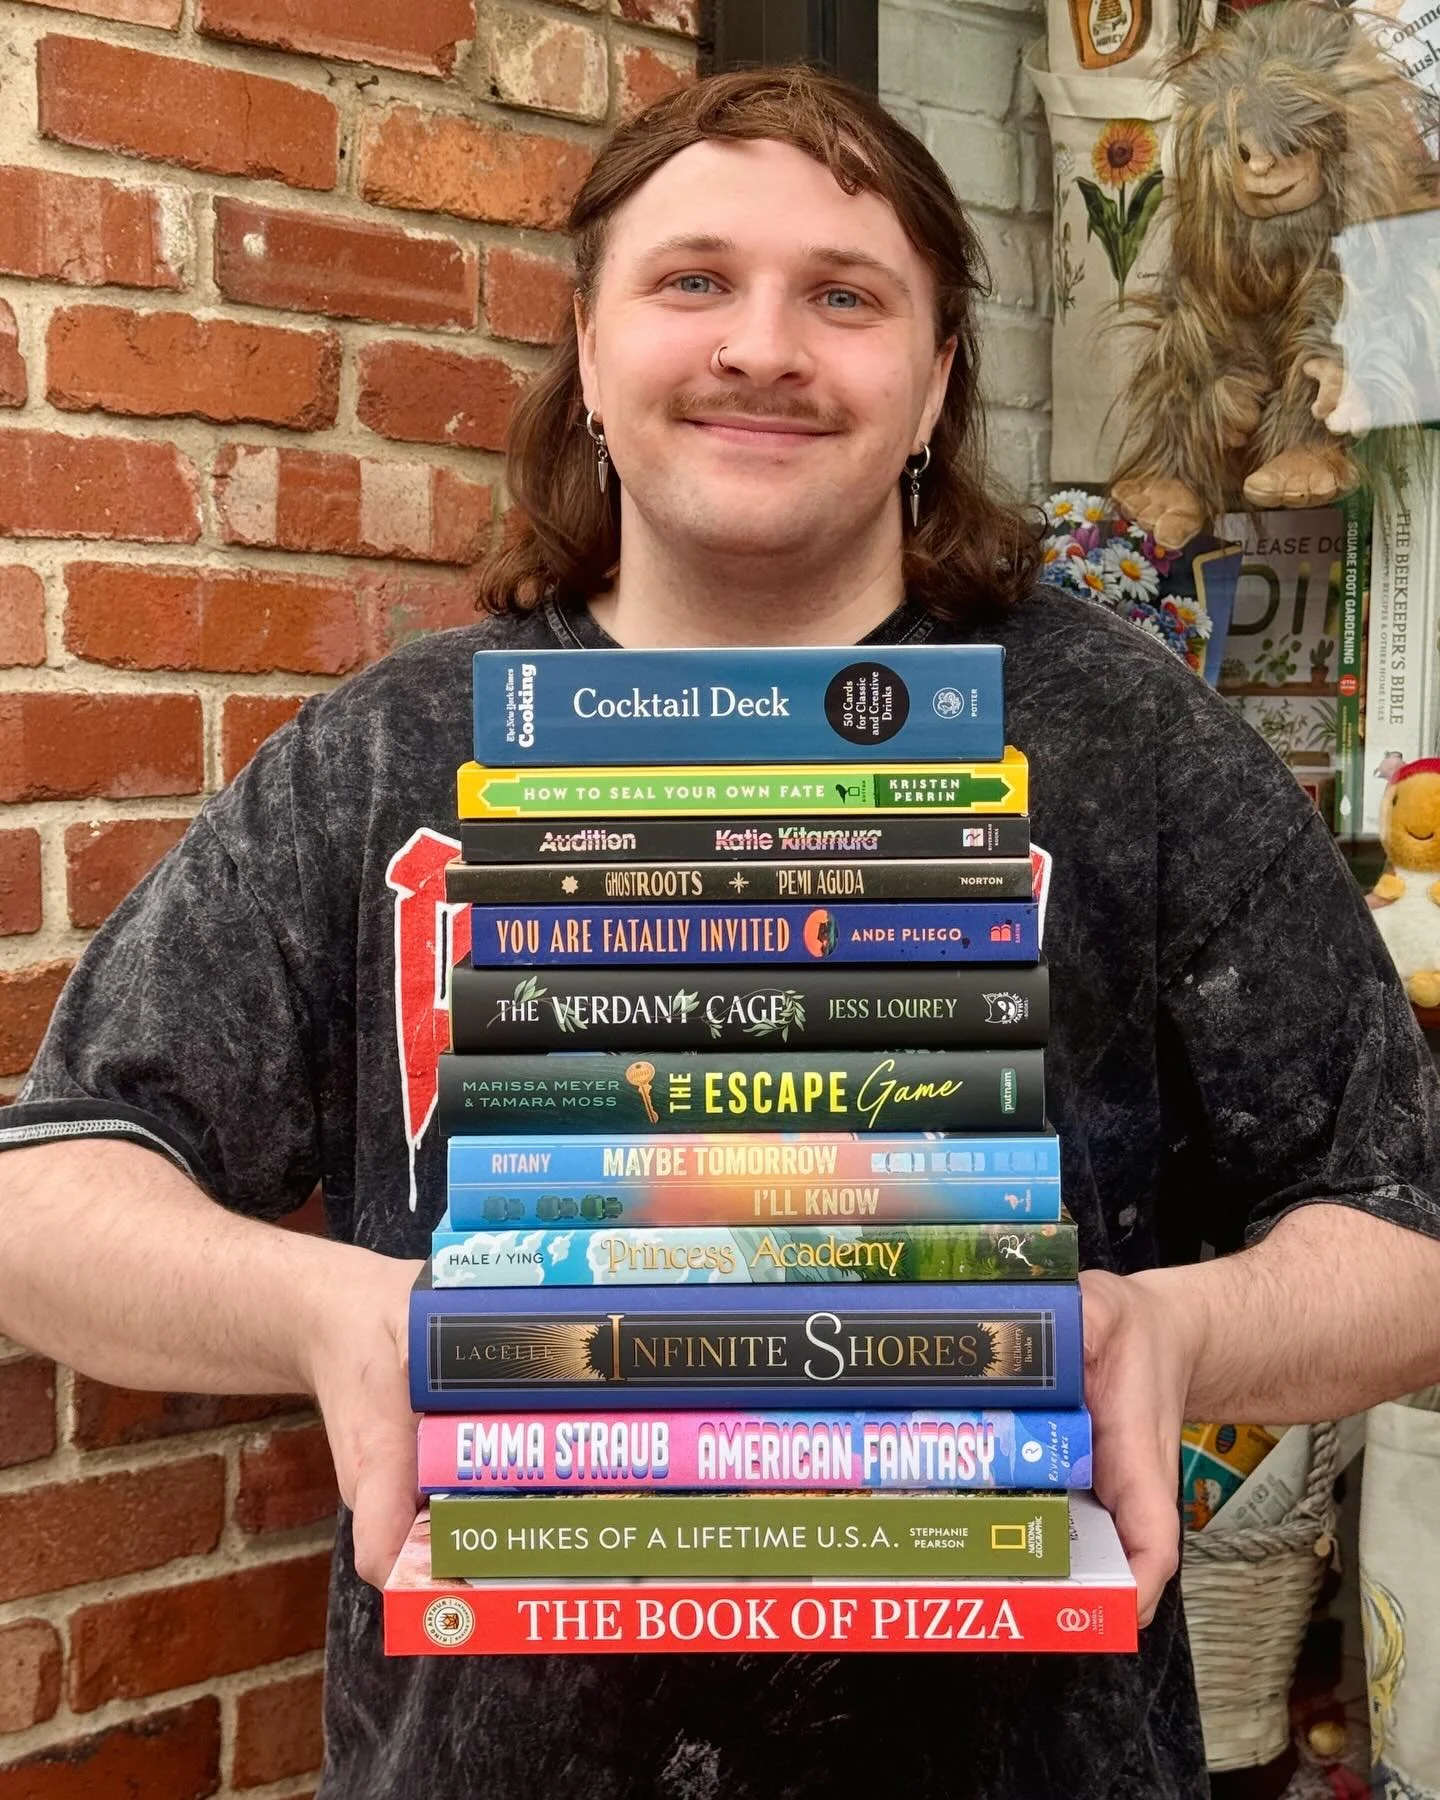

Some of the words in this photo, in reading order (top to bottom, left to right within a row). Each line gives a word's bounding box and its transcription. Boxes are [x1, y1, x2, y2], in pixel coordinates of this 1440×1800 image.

[1345, 520, 1359, 566] SQUARE
[1395, 510, 1412, 548] THE
[1344, 567, 1357, 598] FOOT
[1390, 553, 1409, 671] BEEKEEPER'S
[1342, 598, 1357, 665] GARDENING
[1379, 631, 1388, 666] OTHER
[506, 668, 515, 692] Times
[843, 680, 854, 711] Cards
[856, 677, 867, 710] Classic
[869, 671, 880, 711] Creative
[506, 691, 517, 711] York
[518, 663, 537, 748] Cooking
[573, 687, 700, 719] Cocktail
[710, 686, 790, 718] Deck
[881, 685, 893, 721] Drinks
[970, 688, 978, 717] POTTER
[1389, 675, 1405, 725] BIBLE
[506, 727, 515, 743] The
[507, 711, 515, 728] New
[843, 712, 854, 727] 50
[856, 711, 867, 730] for
[869, 713, 880, 736] and
[524, 787, 568, 801] HOW
[576, 787, 600, 800] TO
[610, 787, 655, 800] SEAL
[664, 785, 716, 799] YOUR
[726, 785, 770, 799] OWN
[780, 784, 825, 798] FATE
[889, 778, 960, 789] KRISTEN
[894, 791, 955, 802] PERRIN
[538, 829, 637, 852] Audition
[715, 828, 773, 850] Katie
[778, 826, 882, 851] Kitamura
[605, 870, 703, 898] GHOSTROOTS
[816, 869, 865, 895] AGUDA
[960, 876, 1004, 885] NORTON
[496, 919, 540, 954] YOU
[551, 919, 593, 953] ARE
[603, 918, 690, 953] FATALLY
[701, 917, 790, 953] INVITED
[851, 928, 895, 942] ANDE
[902, 927, 962, 942] PLIEGO
[497, 999, 540, 1022] THE
[551, 995, 689, 1025] VERDANT
[706, 995, 786, 1025] CAGE
[828, 998, 869, 1021] JESS
[877, 997, 957, 1019] LOUREY
[463, 1080, 548, 1092] MARISSA
[554, 1080, 620, 1091] MEYER
[669, 1072, 691, 1113] THE
[705, 1071, 848, 1114] ESCAPE
[857, 1059, 963, 1128] Game
[1002, 1070, 1016, 1112] putnam
[464, 1098, 473, 1108] &
[480, 1097, 558, 1108] TAMARA
[562, 1096, 617, 1107] MOSS
[491, 1153, 551, 1174] RITANY
[603, 1147, 687, 1177] MAYBE
[693, 1144, 838, 1177] TOMORROW
[753, 1188, 798, 1217] I'LL
[805, 1187, 880, 1216] KNOW
[449, 1254, 490, 1266] HALE
[495, 1253, 502, 1265] /
[505, 1252, 545, 1265] YING
[601, 1237, 737, 1274] Princess
[750, 1234, 905, 1277] Academy
[606, 1313, 788, 1381] INFINITE
[803, 1311, 978, 1381] SHORES
[1012, 1326, 1024, 1374] McElderry
[1024, 1335, 1033, 1364] Books
[457, 1421, 545, 1481] EMMA
[555, 1421, 669, 1481] STRAUB
[697, 1421, 852, 1481] AMERICAN
[863, 1421, 995, 1481] FANTASY
[1048, 1420, 1059, 1482] Riverhead
[450, 1528, 498, 1551] 100
[507, 1527, 589, 1550] HIKES
[599, 1527, 638, 1550] OF
[646, 1527, 668, 1549] A
[677, 1526, 807, 1549] LIFETIME
[817, 1526, 900, 1549] U.S.A.
[908, 1527, 969, 1538] STEPHANIE
[914, 1539, 965, 1549] PEARSON
[1035, 1516, 1043, 1559] GEOGRAPHIC
[427, 1600, 448, 1627] ARTHUR
[517, 1599, 623, 1641] THE
[635, 1599, 779, 1641] BOOK
[790, 1598, 859, 1640] OF
[871, 1598, 1025, 1640] PIZZA
[429, 1628, 448, 1643] KING
